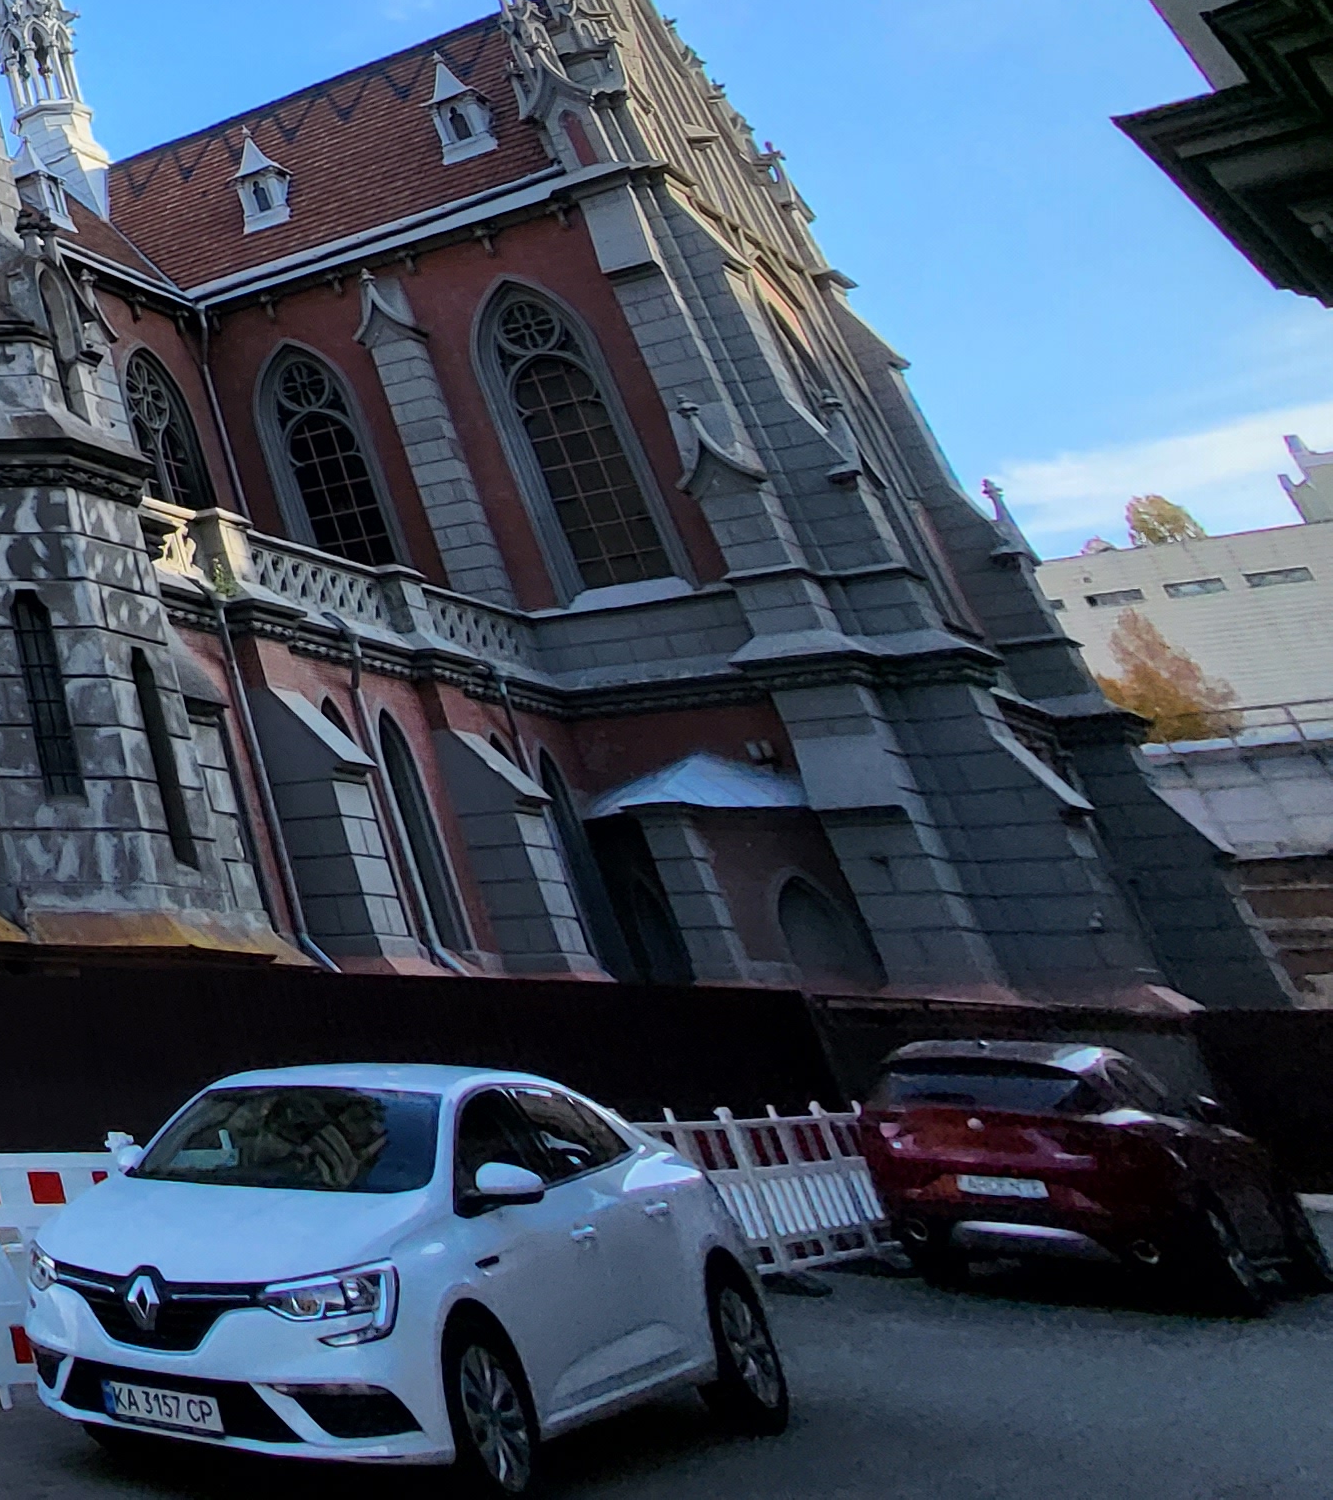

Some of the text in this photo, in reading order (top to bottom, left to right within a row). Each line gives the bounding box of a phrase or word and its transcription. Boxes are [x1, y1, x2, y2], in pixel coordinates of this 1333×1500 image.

[113, 1386, 213, 1424] KA 3157 CP
